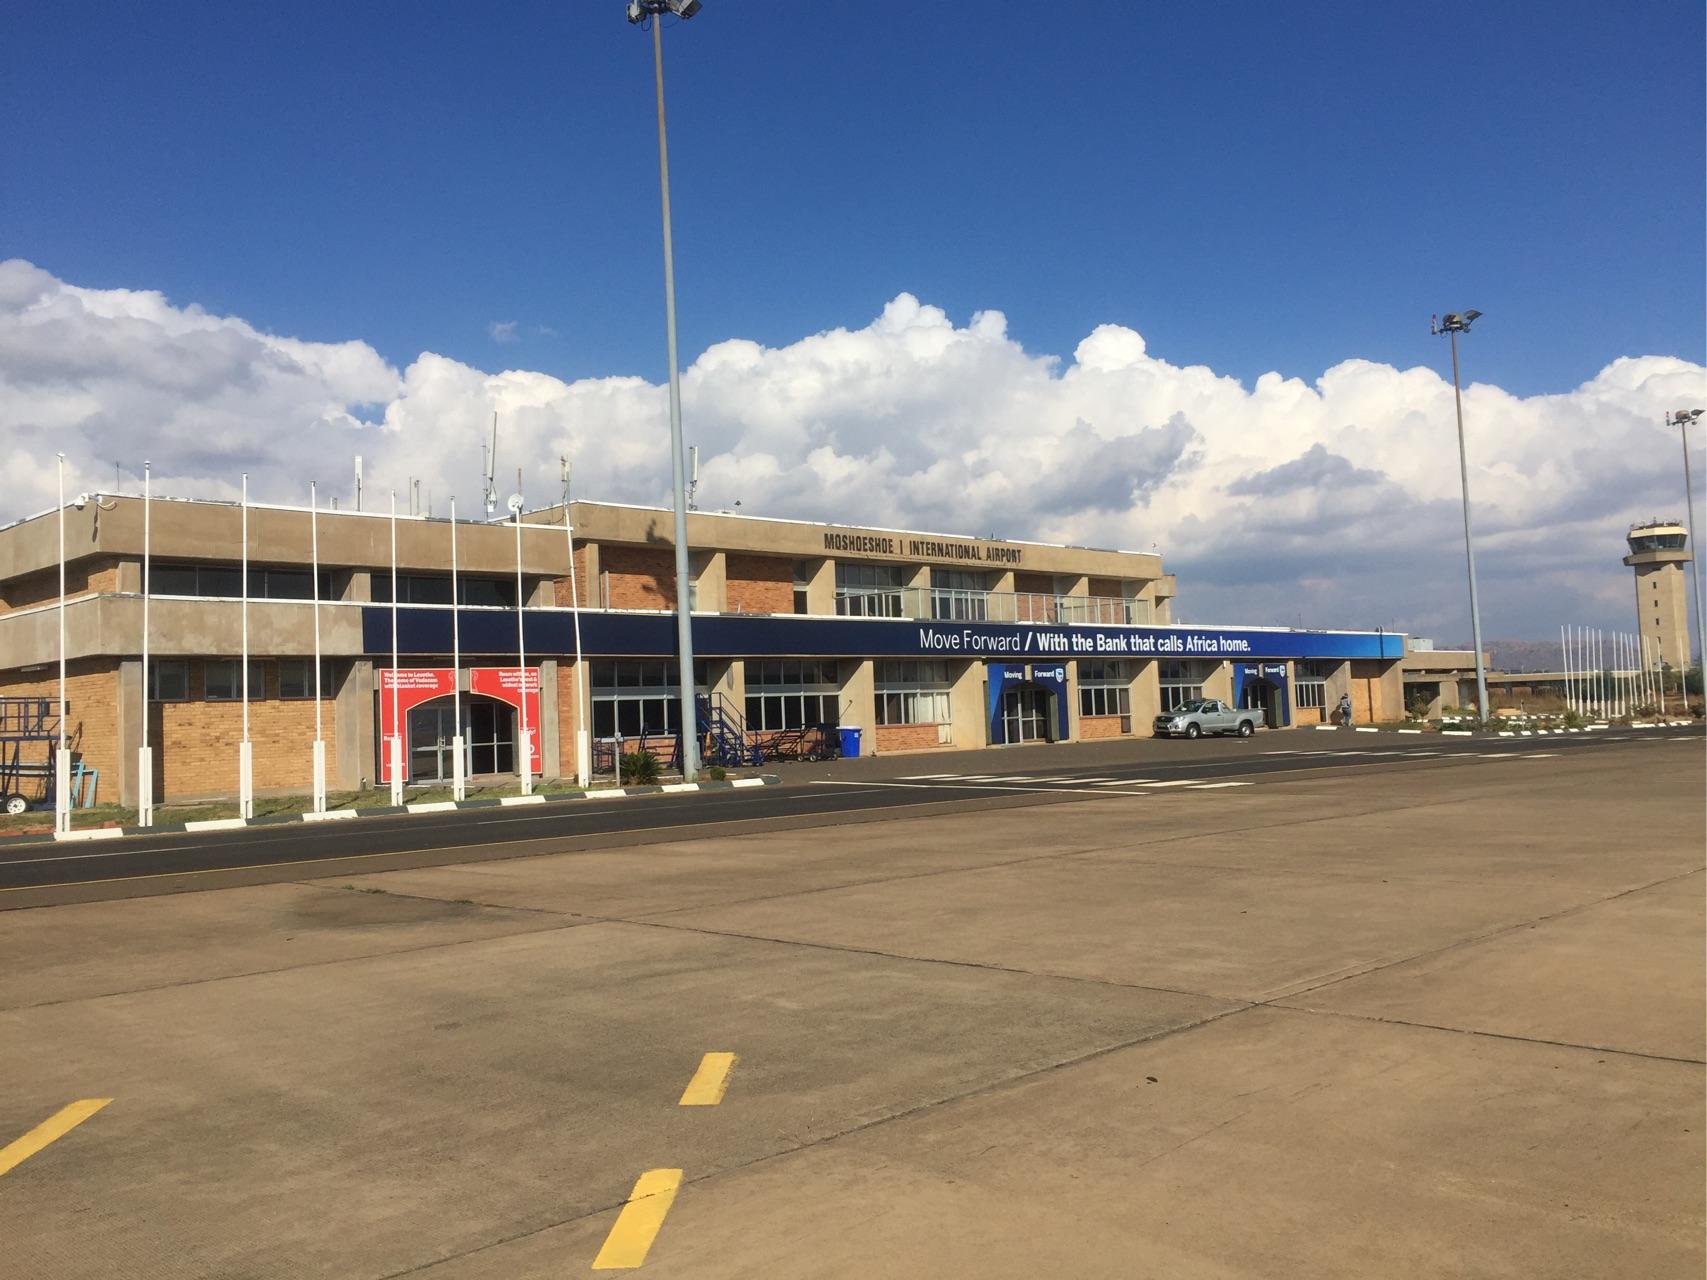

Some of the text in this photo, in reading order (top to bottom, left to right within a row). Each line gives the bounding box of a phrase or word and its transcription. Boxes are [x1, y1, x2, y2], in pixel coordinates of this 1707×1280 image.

[824, 533, 1022, 563] MOSHOESHOE I INTERNATIONAL AIRPORT
[920, 628, 1251, 652] Move Forward / With the Bank that calls Africa home.
[1004, 670, 1055, 680] Moving Forward
